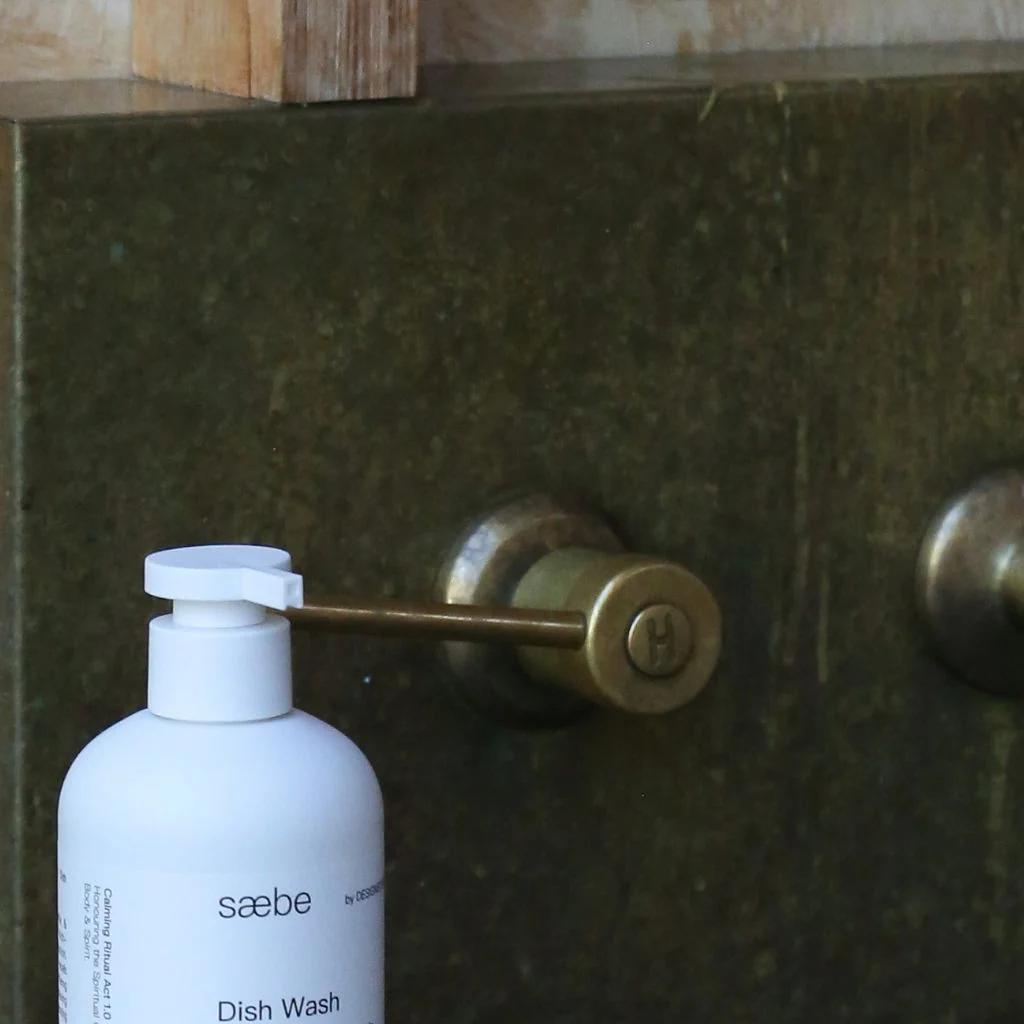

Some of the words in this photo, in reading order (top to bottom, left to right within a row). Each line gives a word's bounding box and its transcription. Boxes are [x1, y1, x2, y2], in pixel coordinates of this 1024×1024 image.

[84, 882, 92, 913] Body
[102, 888, 112, 937] Calming
[218, 886, 312, 919] sæbe
[344, 894, 353, 906] by
[84, 915, 91, 925] &
[92, 885, 101, 945] Honouring
[103, 940, 112, 976] Ritual
[93, 971, 101, 1018] Spiritual
[103, 979, 112, 999] Act
[103, 1004, 112, 1020] 1.0
[218, 999, 272, 1022] Dish
[282, 991, 340, 1019] Wash
